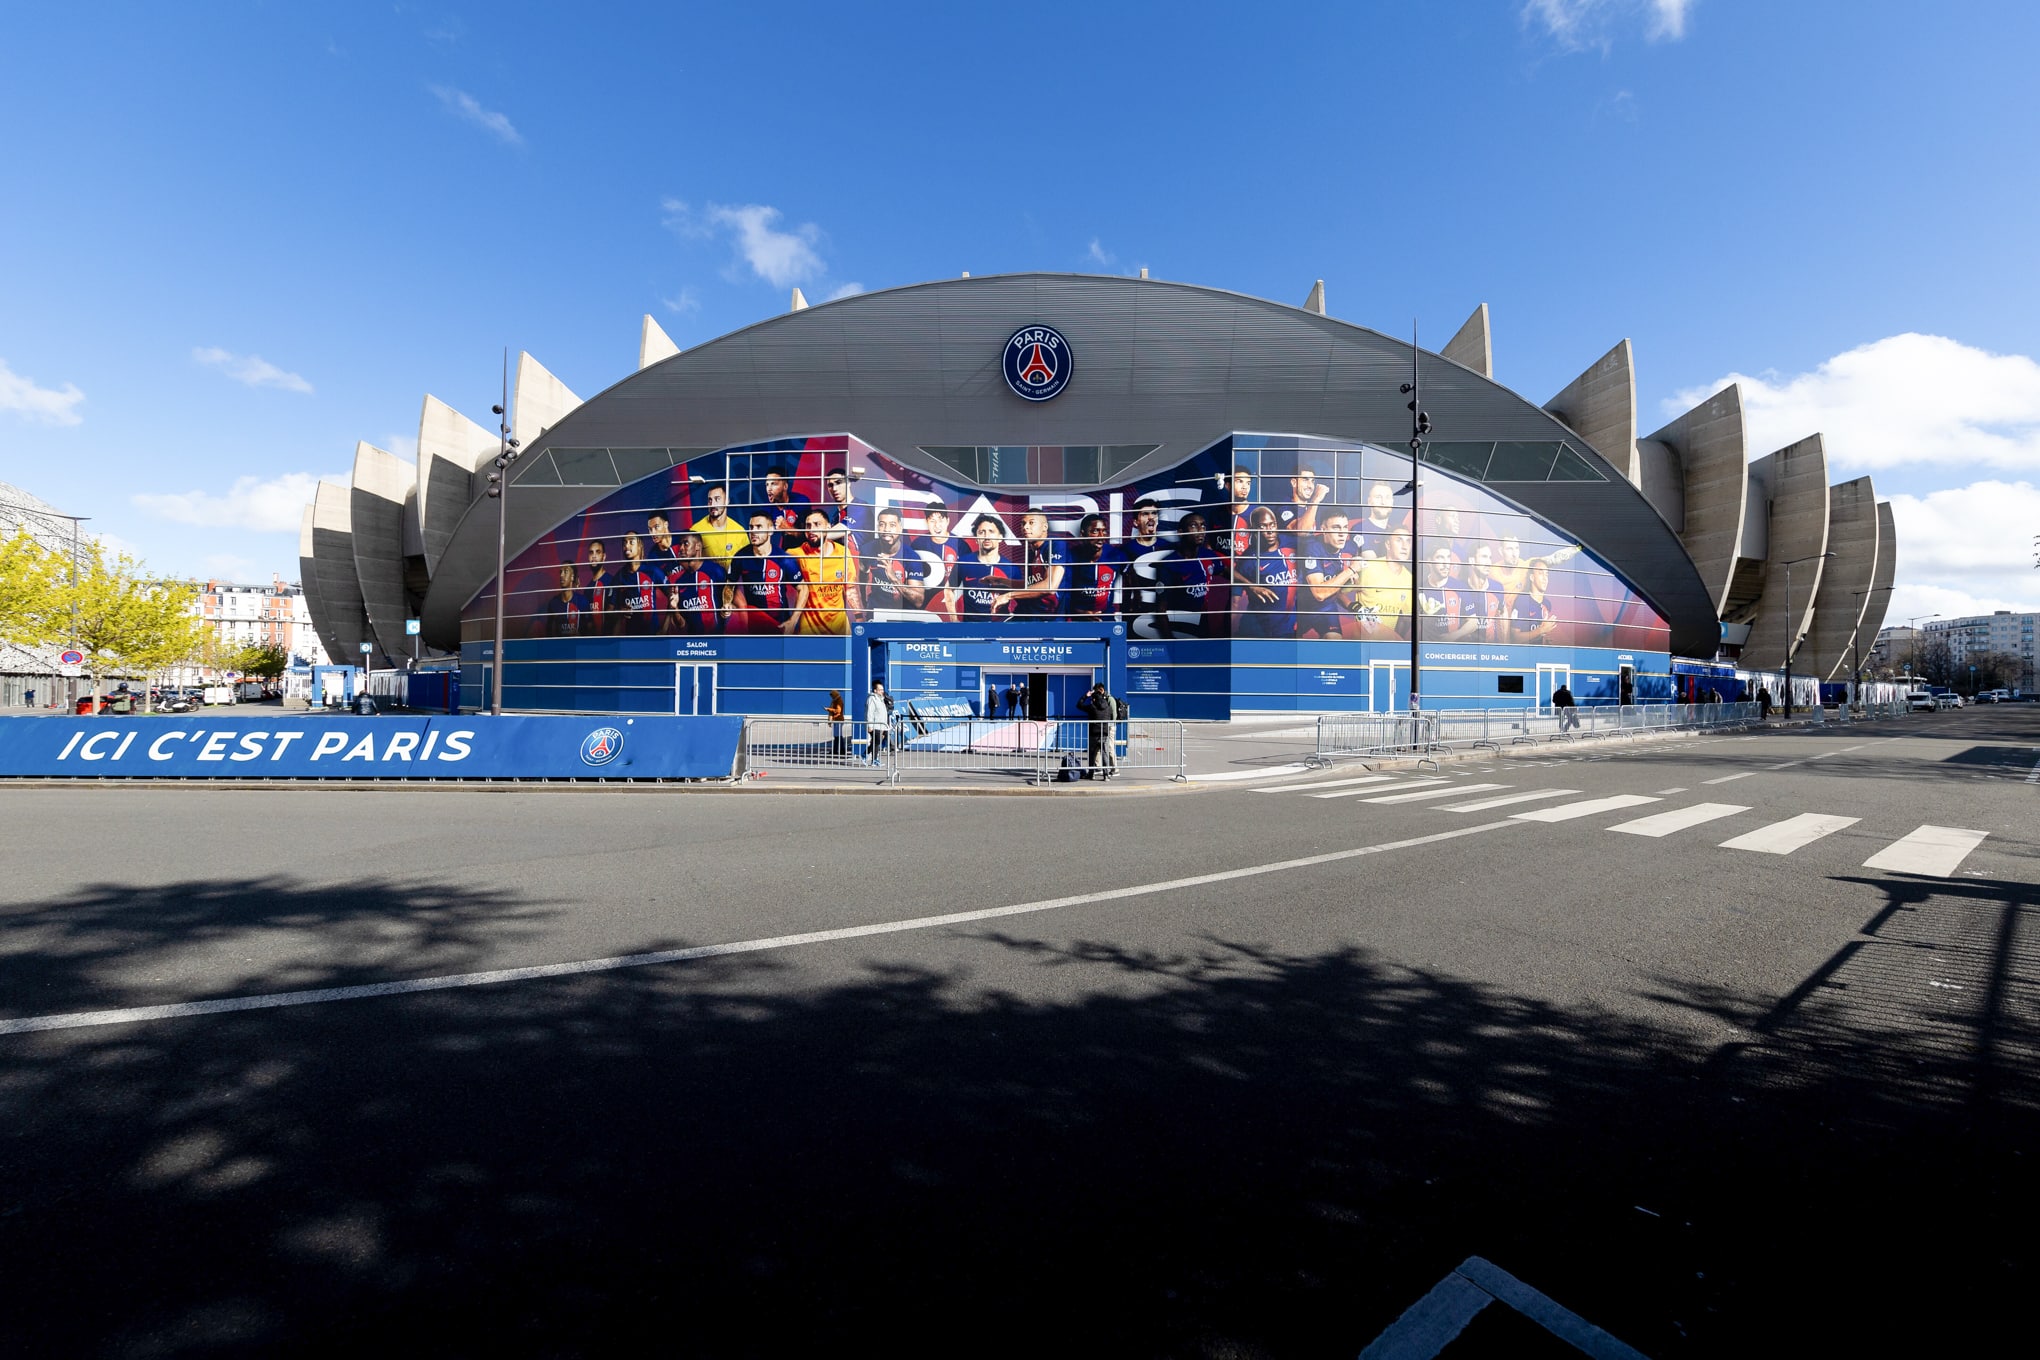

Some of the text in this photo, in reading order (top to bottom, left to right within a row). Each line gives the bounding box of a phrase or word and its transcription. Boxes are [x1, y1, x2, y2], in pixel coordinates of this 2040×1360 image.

[1014, 330, 1060, 349] PARIS
[875, 487, 1203, 546] PARIS
[1265, 568, 1298, 585] QATAR
[683, 595, 708, 609] QATAR
[906, 644, 953, 657] PORTE L
[1002, 646, 1073, 655] BIENVENUE
[592, 729, 620, 740] PARIS
[57, 731, 475, 761] ICI C'EST PARIS
